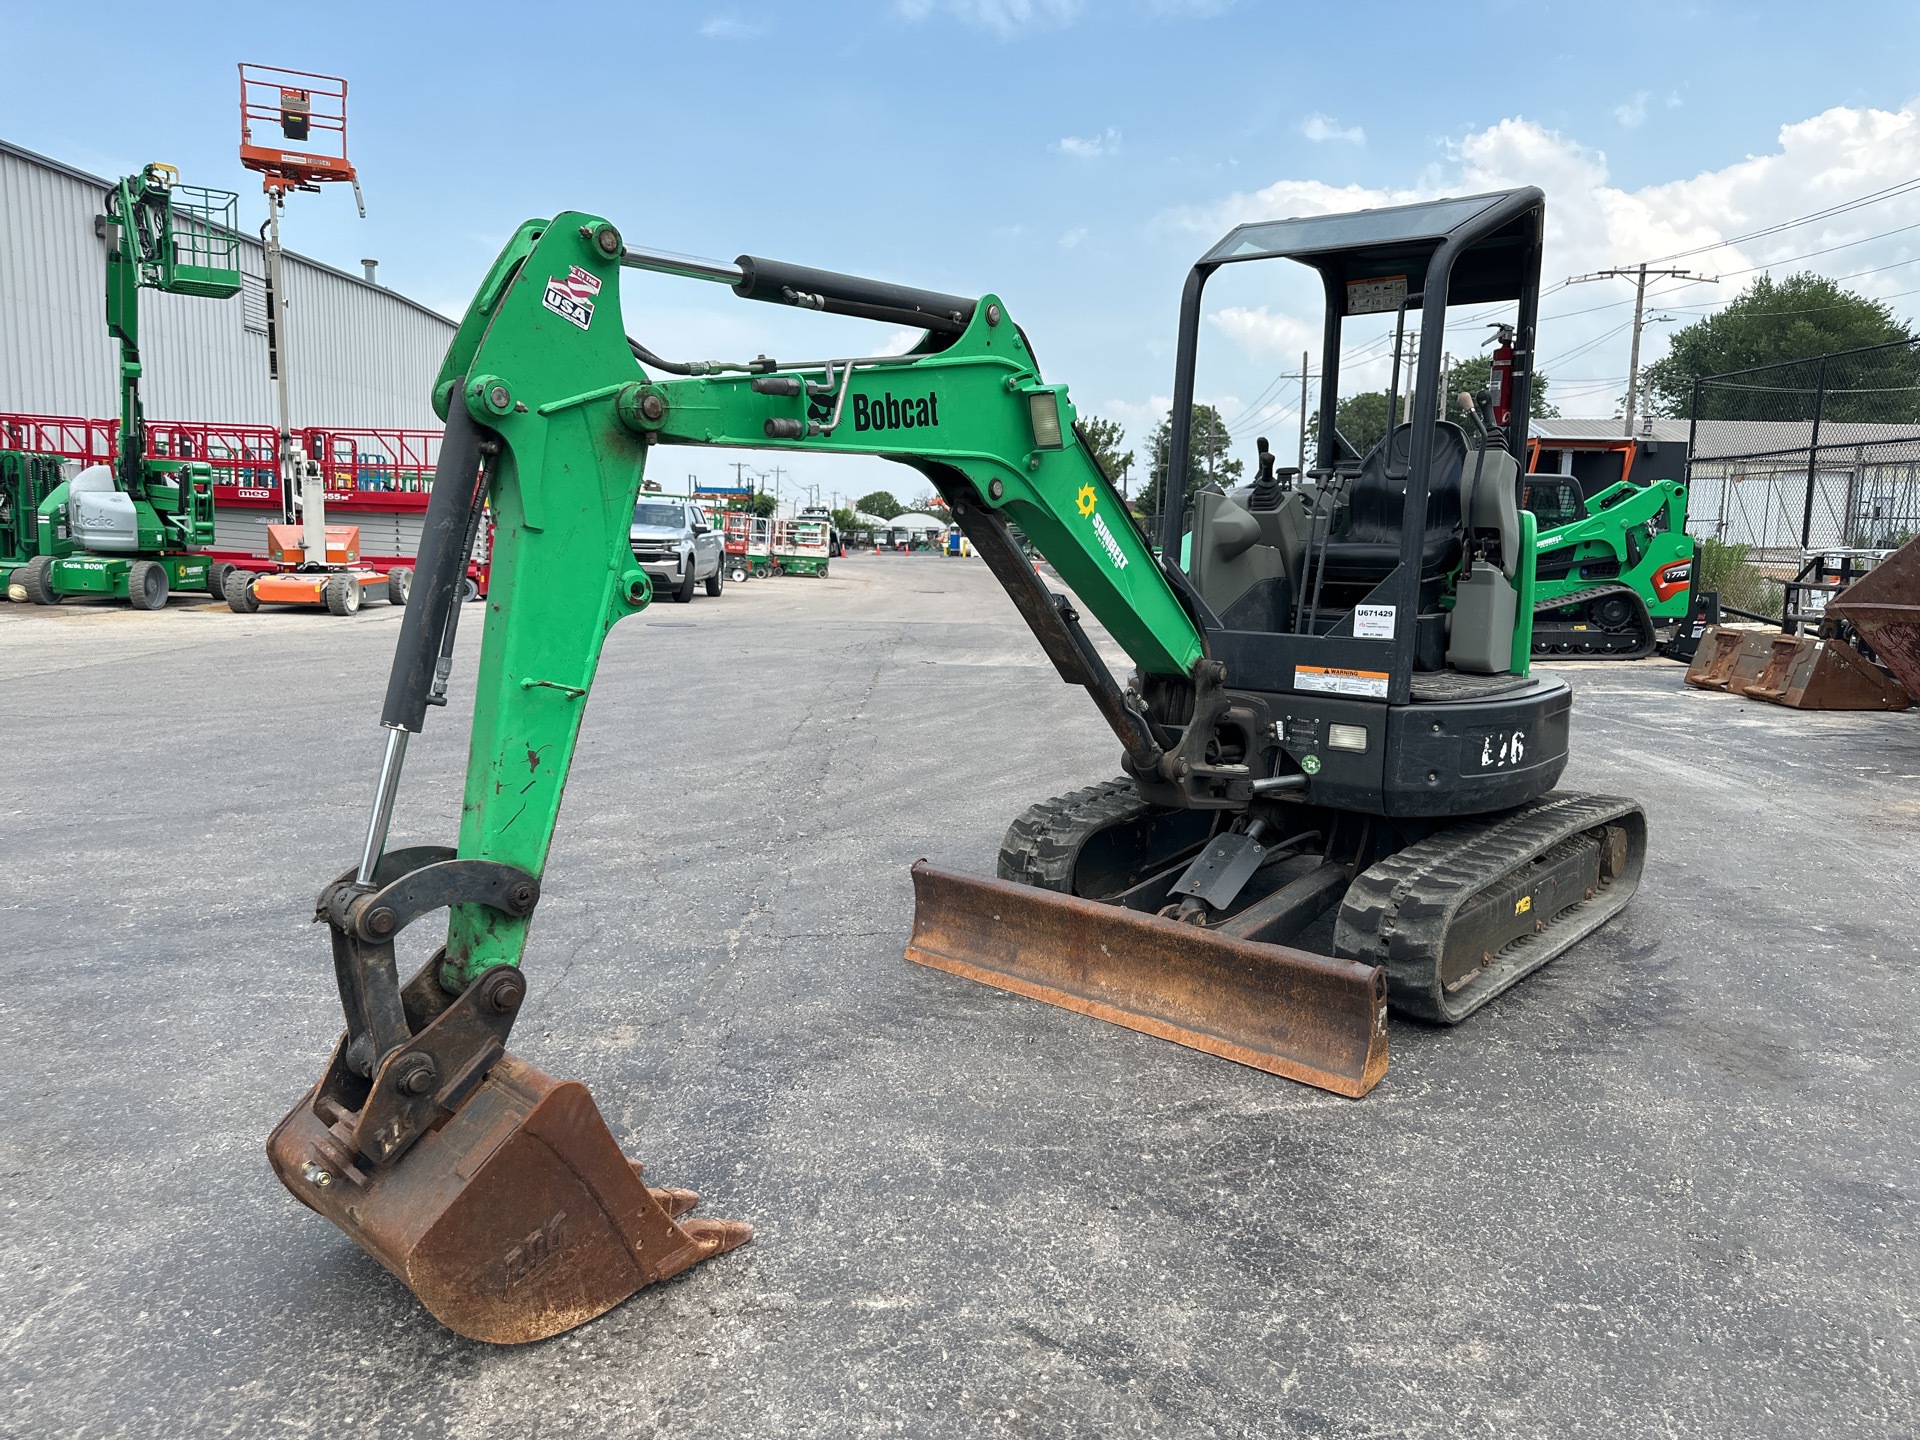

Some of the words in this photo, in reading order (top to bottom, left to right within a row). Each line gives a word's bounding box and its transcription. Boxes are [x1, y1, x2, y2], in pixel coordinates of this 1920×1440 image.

[585, 275, 598, 287] THE
[546, 290, 587, 323] USA
[853, 392, 938, 431] Bobcat
[239, 489, 268, 498] mec
[1092, 512, 1129, 570] SUNBELT
[1666, 571, 1687, 579] T770
